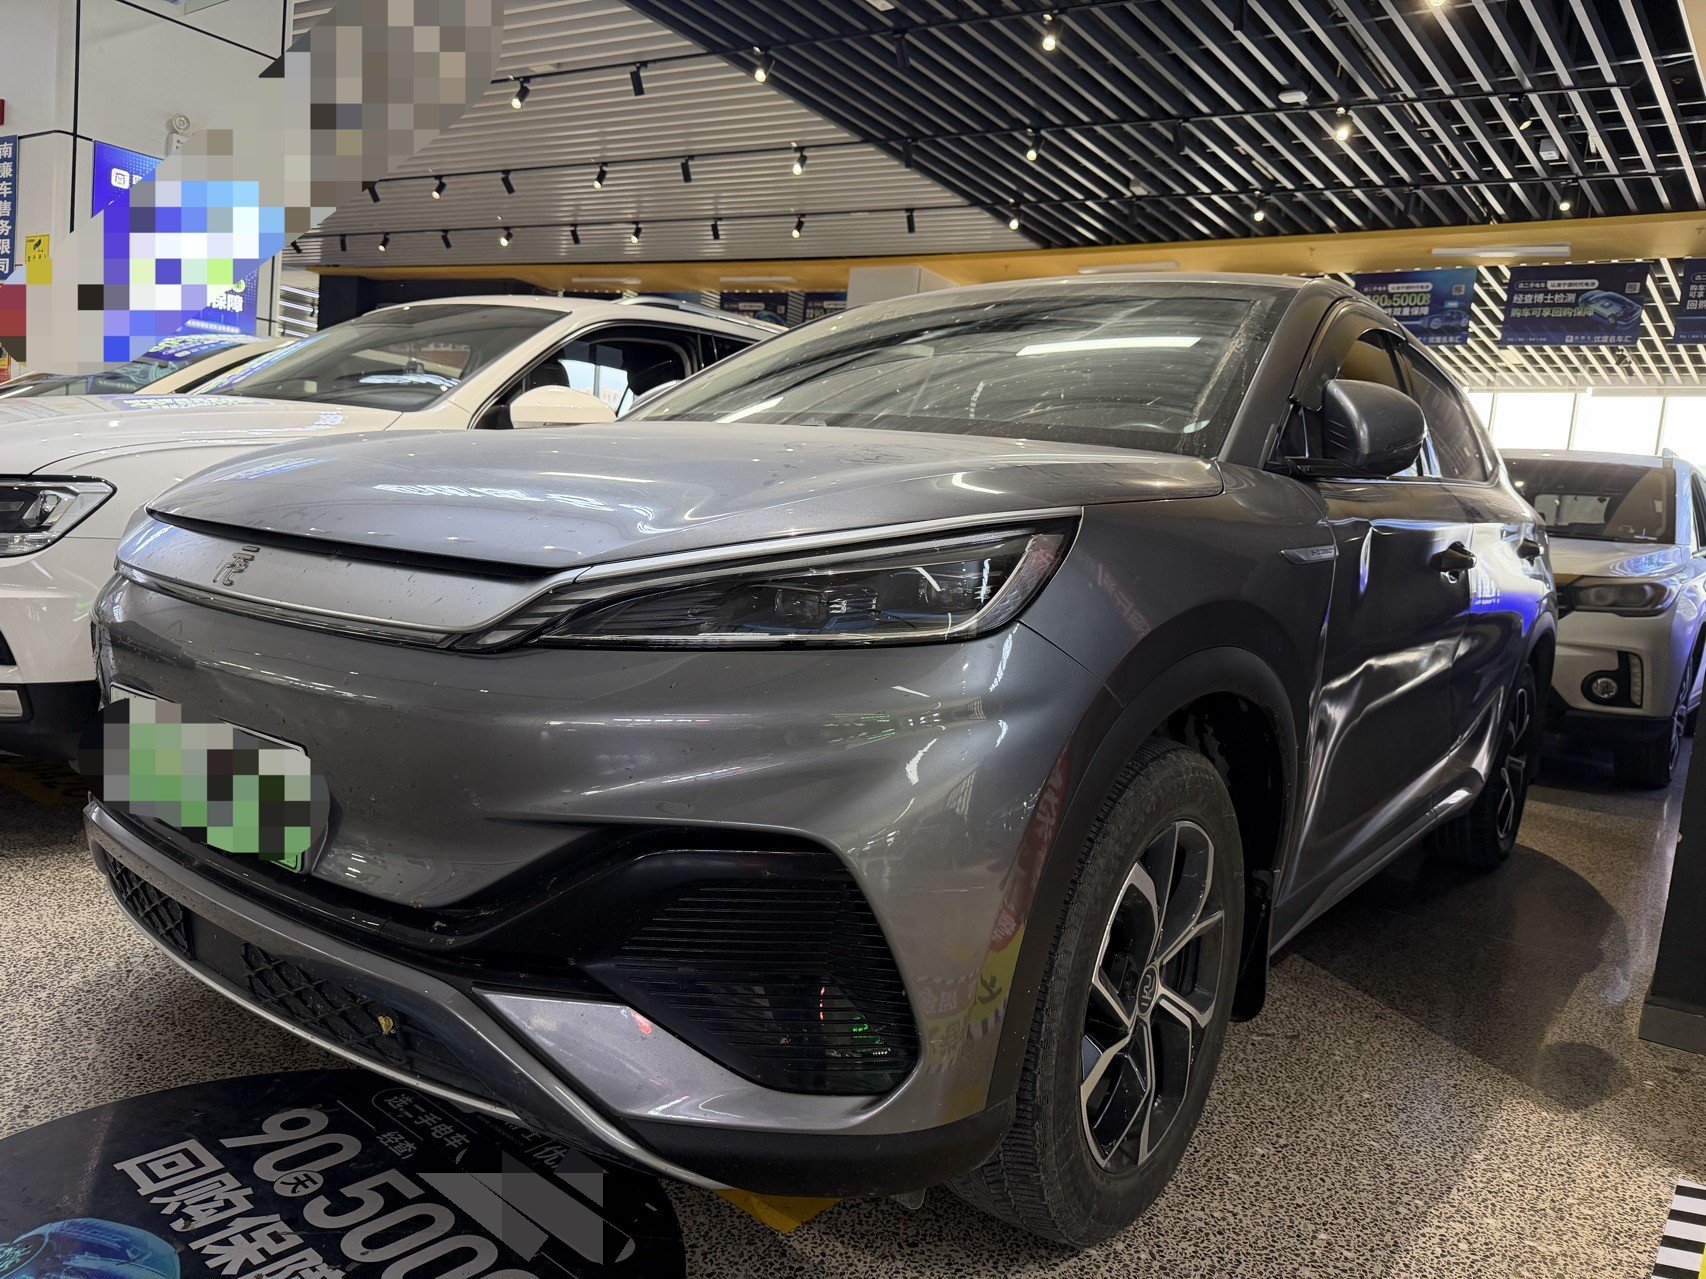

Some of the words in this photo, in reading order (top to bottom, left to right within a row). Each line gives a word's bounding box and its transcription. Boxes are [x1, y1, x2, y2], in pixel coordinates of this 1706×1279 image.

[1512, 293, 1576, 304] 经查博士检测
[384, 1092, 470, 1149] 选二手电车
[376, 1130, 417, 1160] 经查
